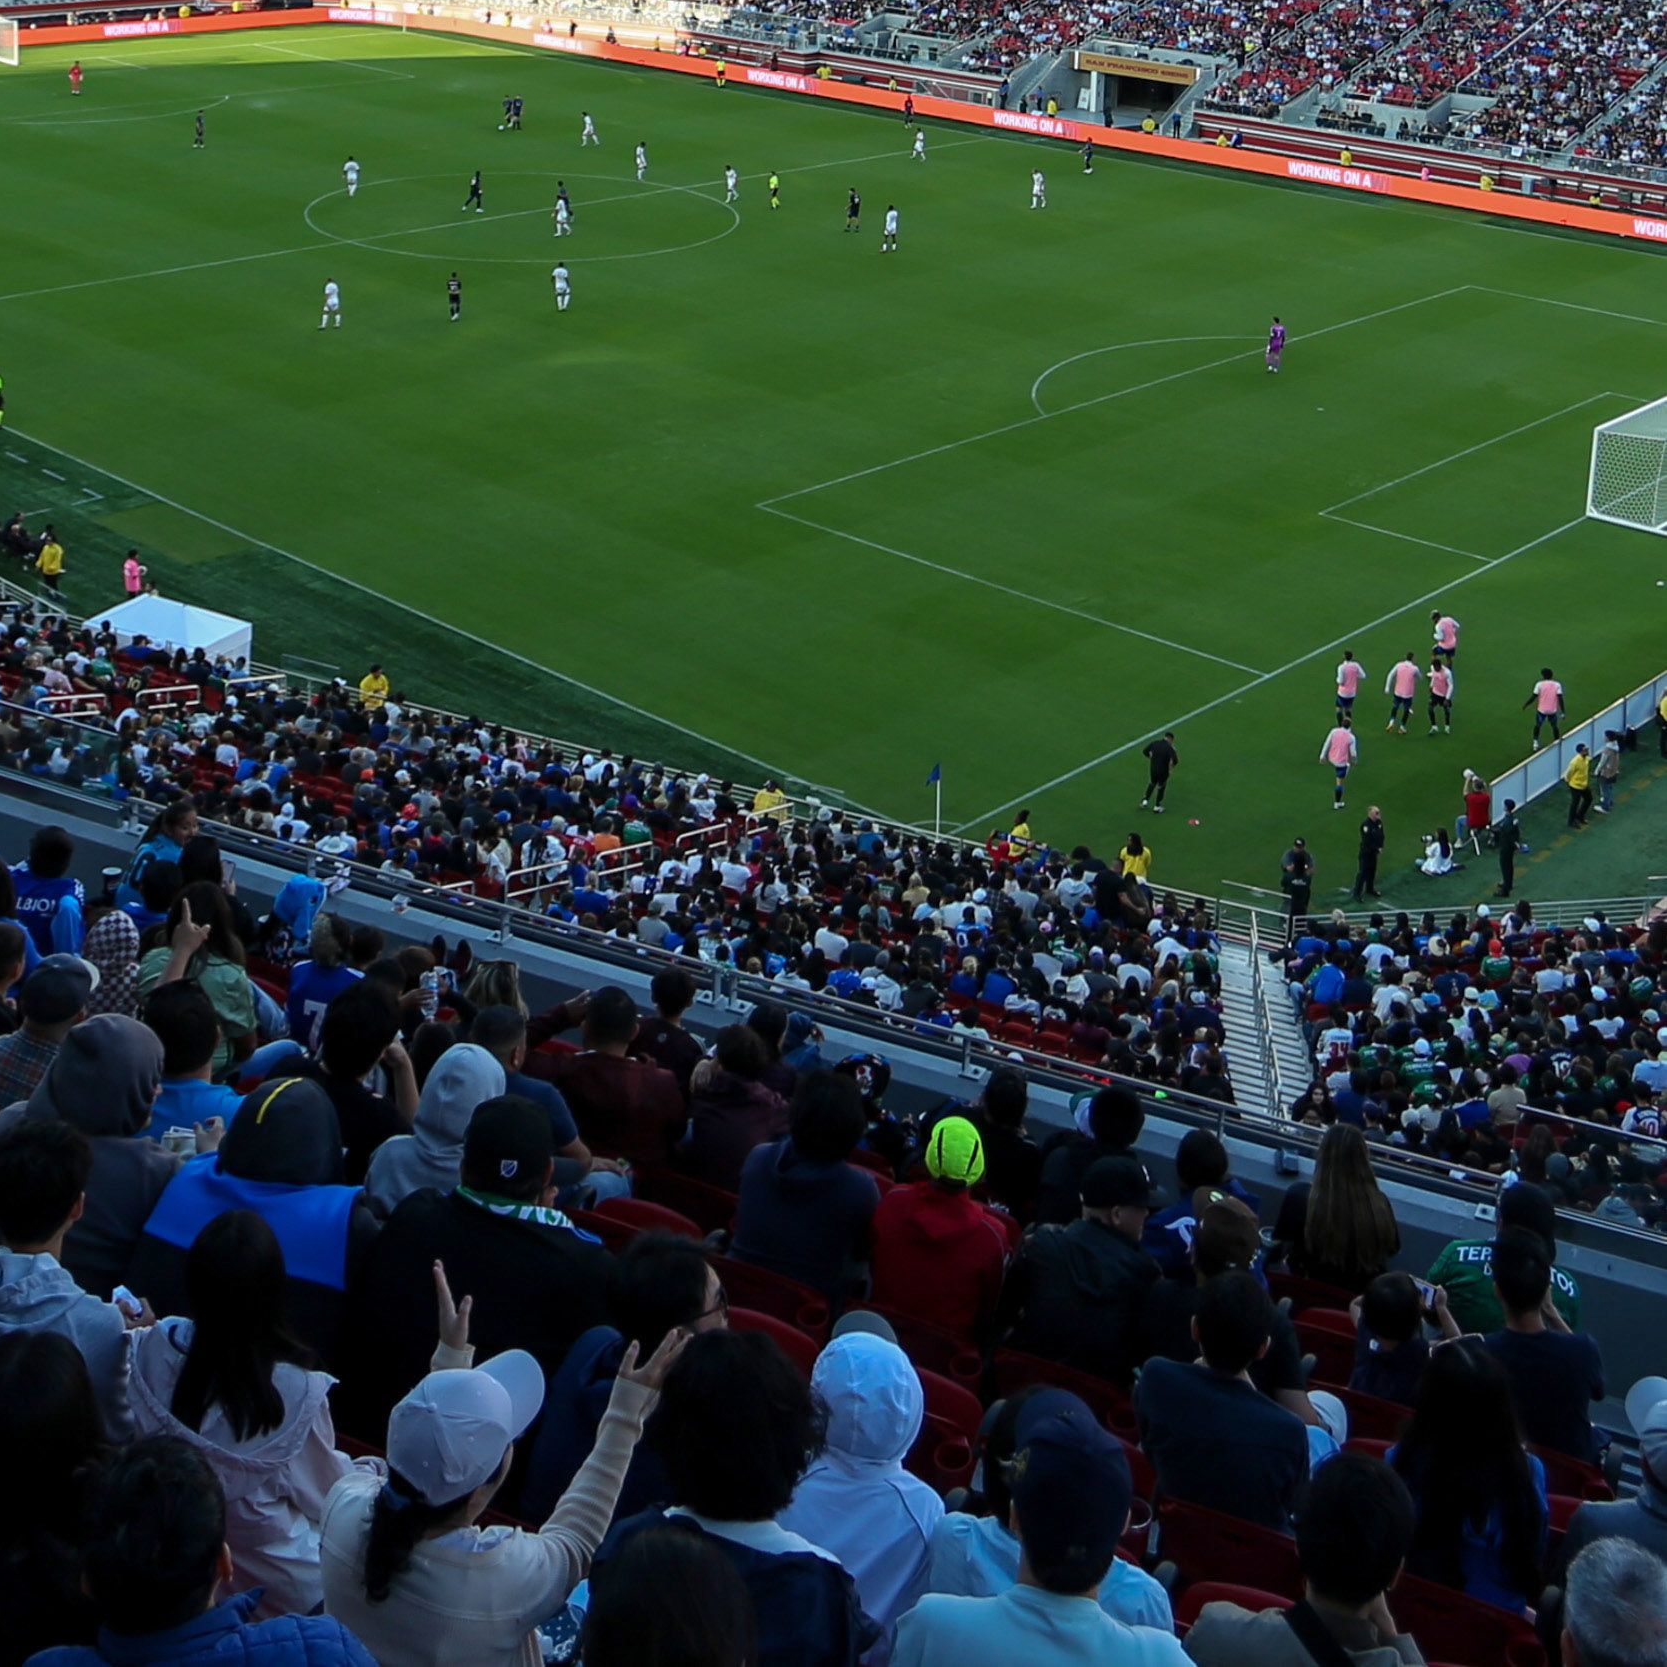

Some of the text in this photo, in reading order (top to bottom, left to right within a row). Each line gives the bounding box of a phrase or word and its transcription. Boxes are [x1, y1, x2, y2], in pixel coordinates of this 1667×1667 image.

[104, 23, 147, 36] WORKING
[147, 22, 161, 34] ON
[747, 69, 784, 87] WORKING
[785, 75, 798, 89] ON
[994, 112, 1064, 136] WORKING ON A
[1287, 161, 1373, 189] WORKING ON A
[1634, 218, 1667, 238] WOR
